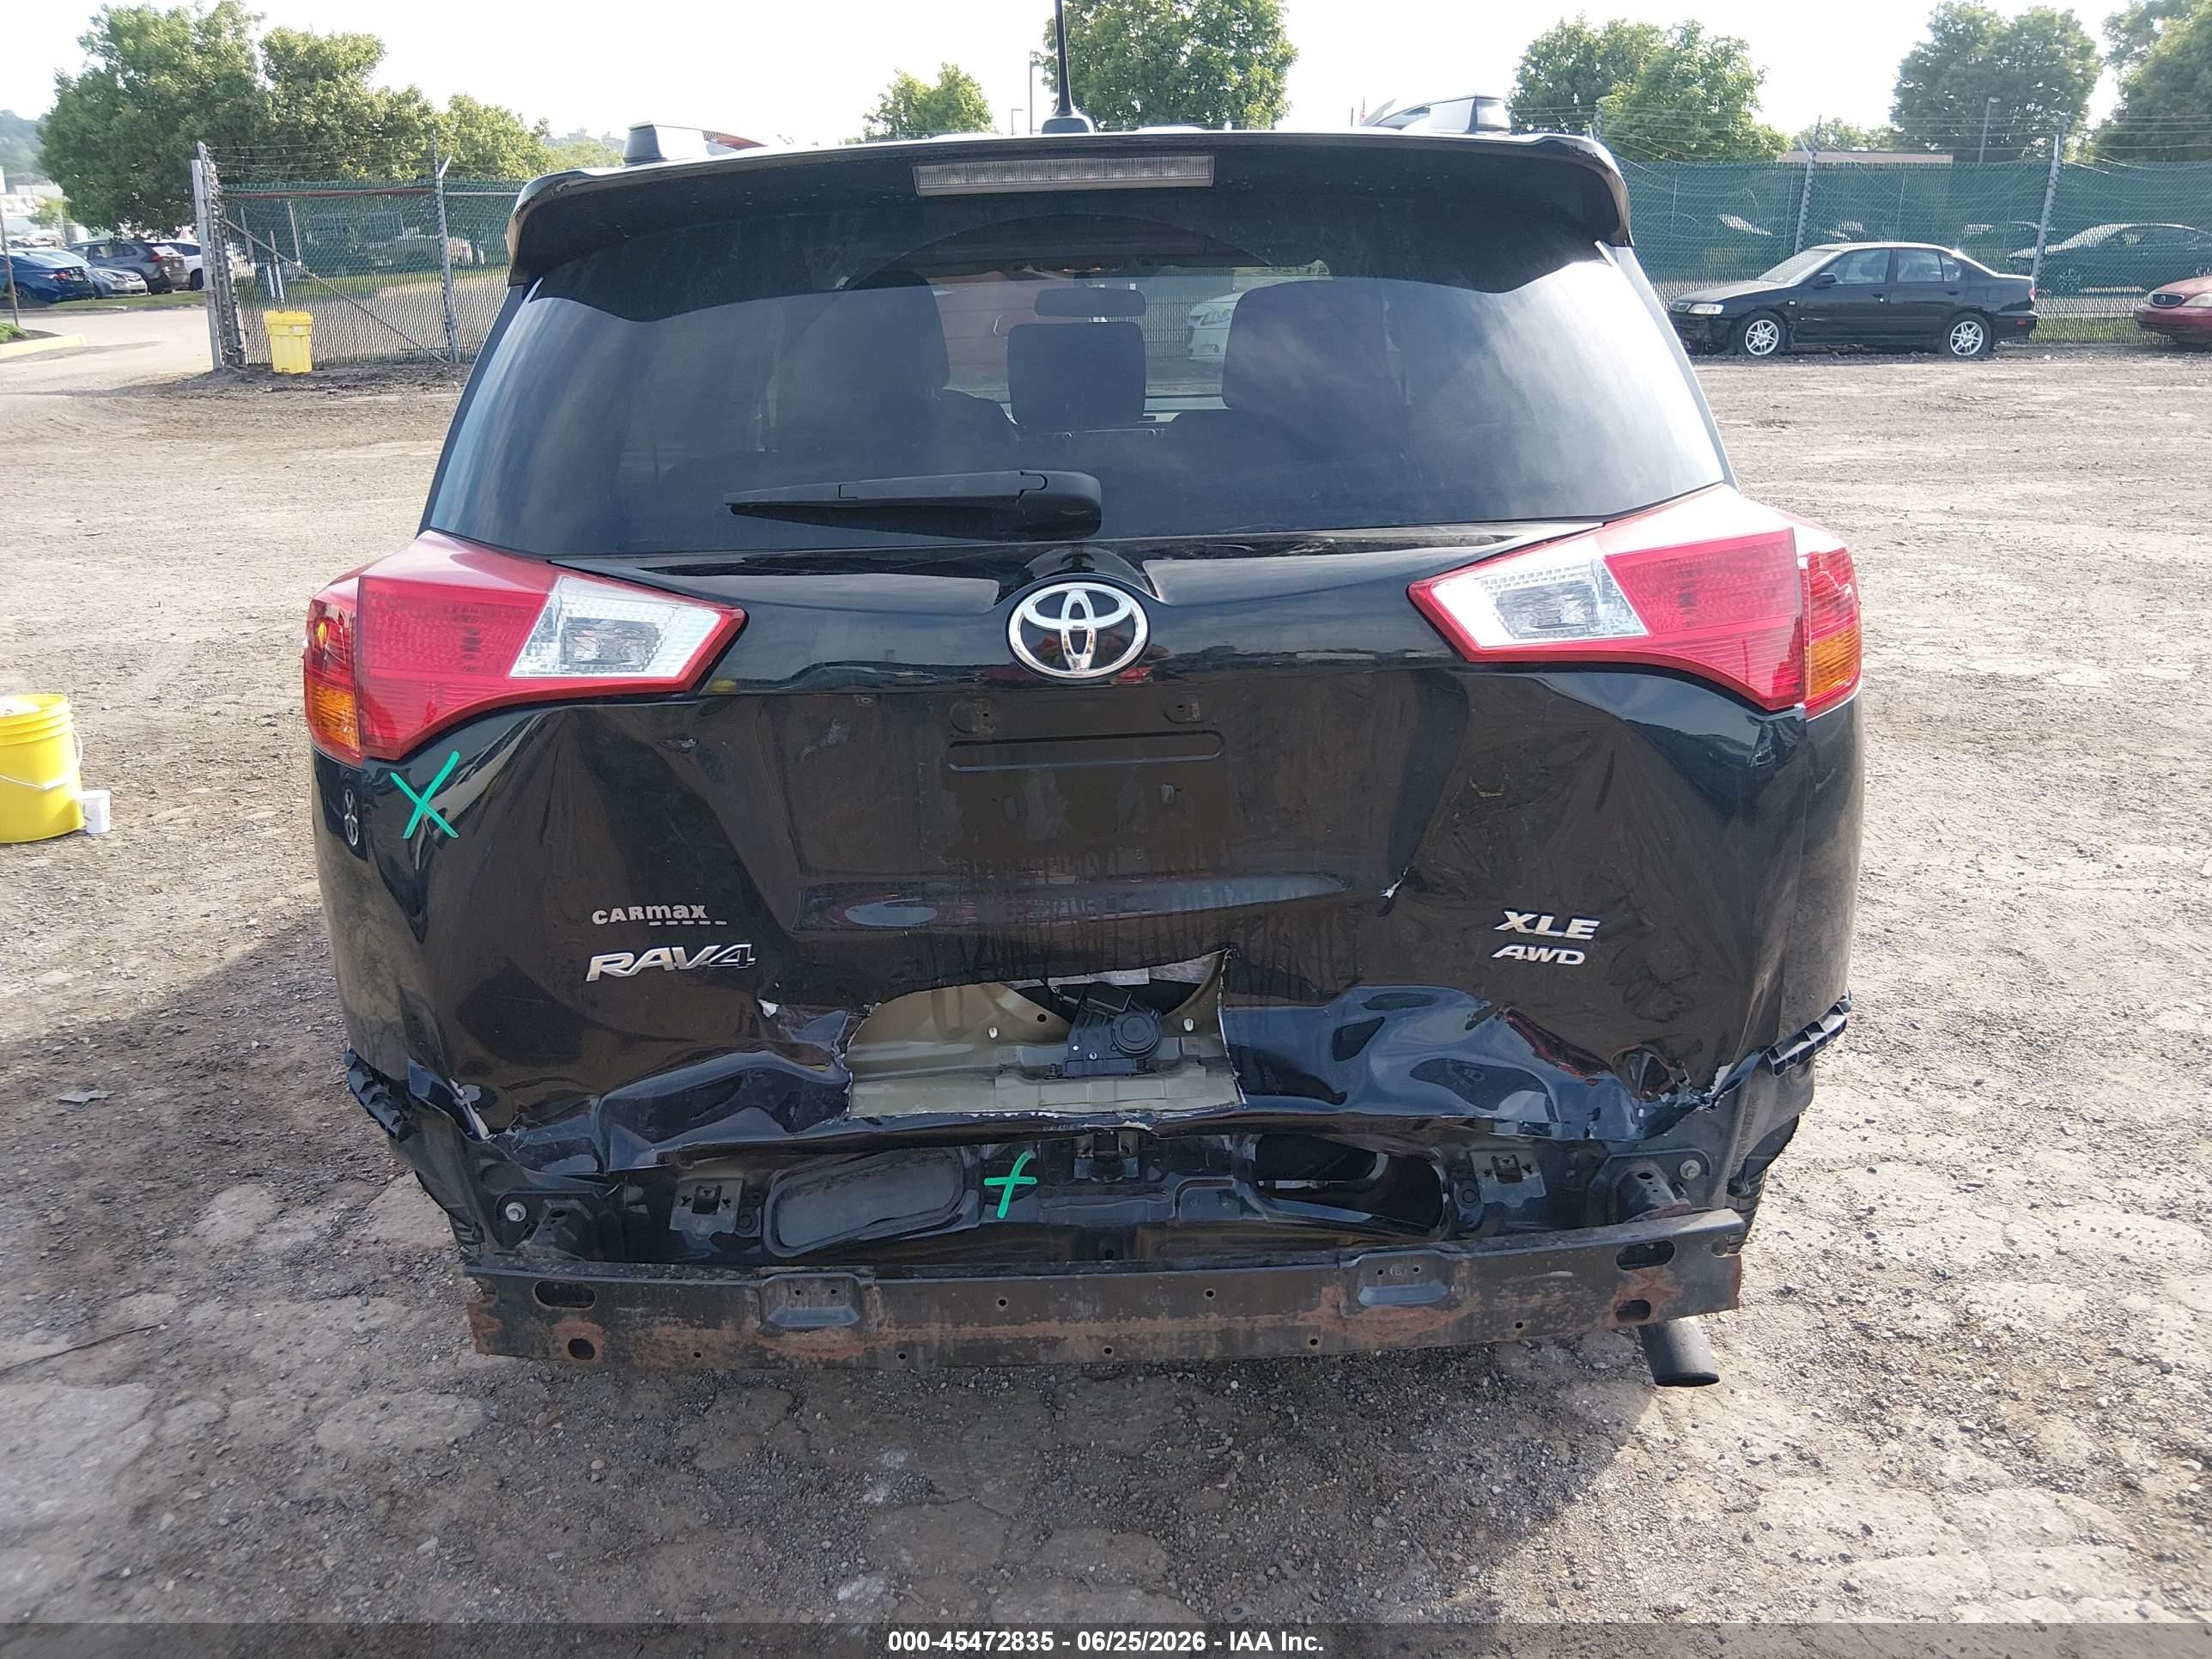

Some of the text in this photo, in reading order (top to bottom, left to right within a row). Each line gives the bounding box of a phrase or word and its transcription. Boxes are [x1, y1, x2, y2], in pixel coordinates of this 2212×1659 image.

[1493, 910, 1601, 940] XLE
[585, 943, 757, 982] RAV4
[1491, 944, 1587, 966] AWD
